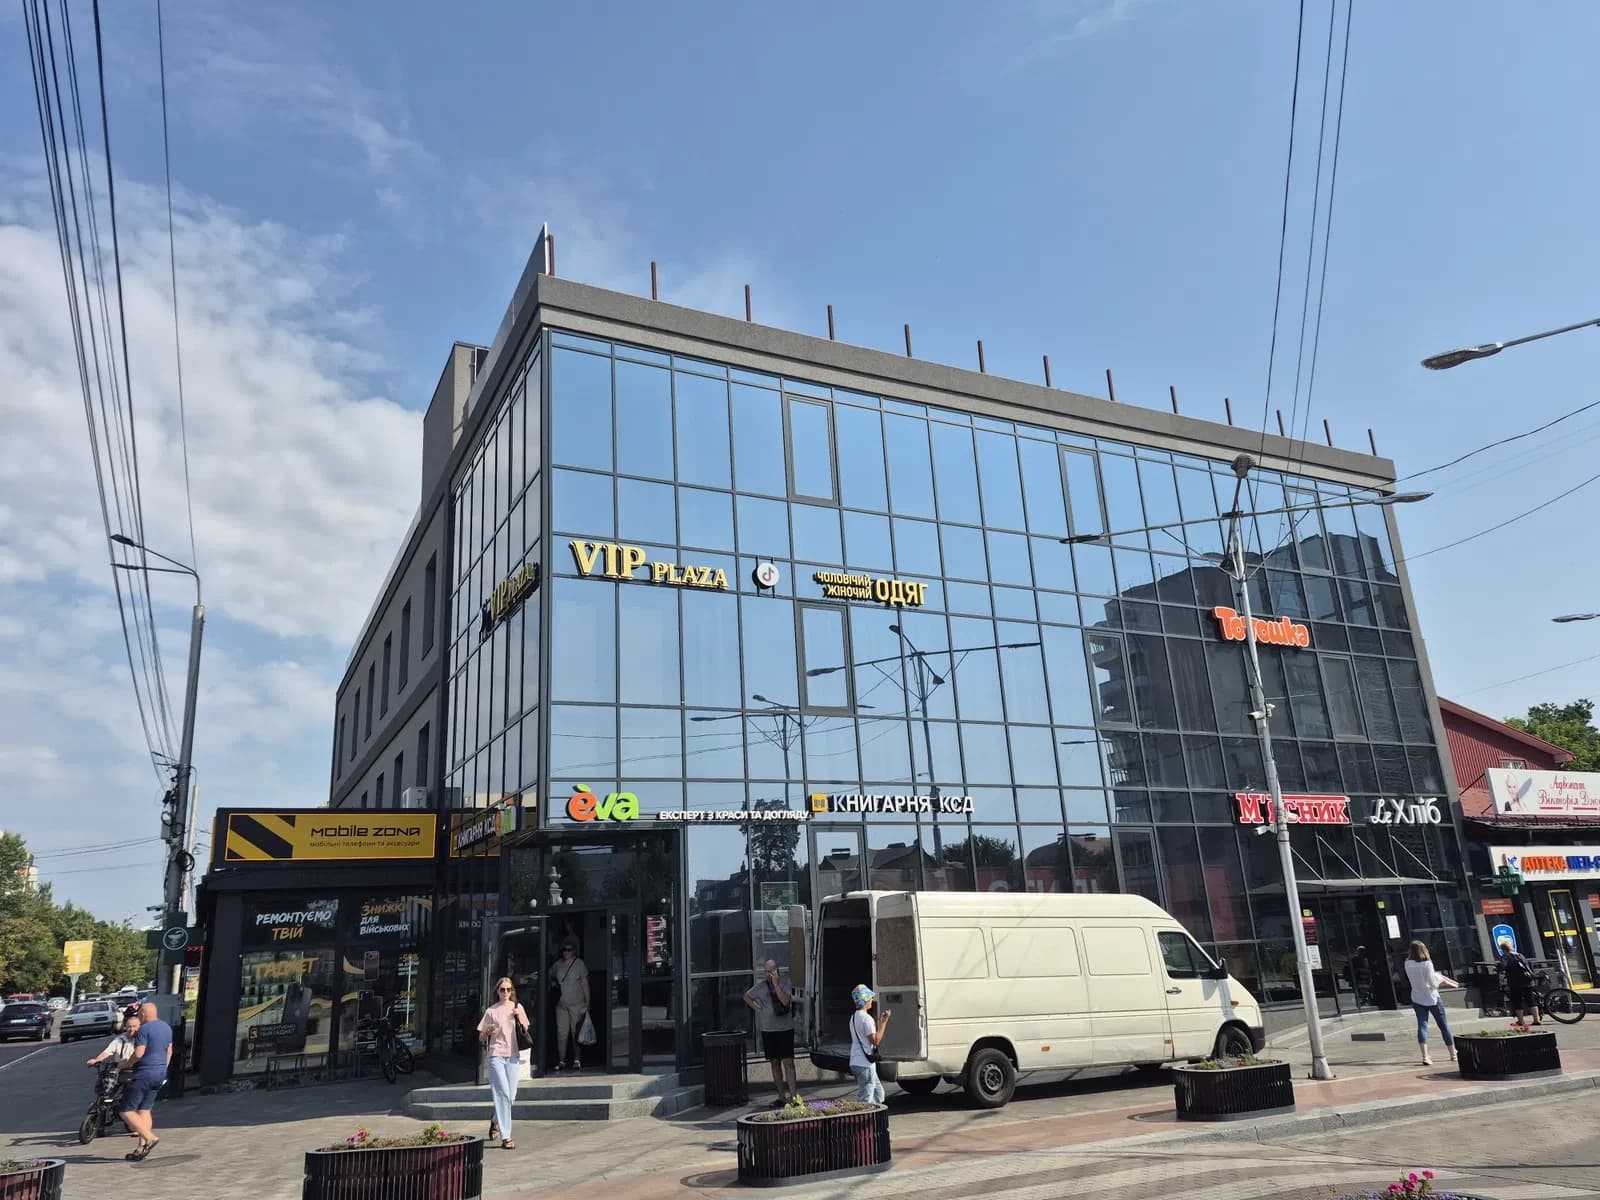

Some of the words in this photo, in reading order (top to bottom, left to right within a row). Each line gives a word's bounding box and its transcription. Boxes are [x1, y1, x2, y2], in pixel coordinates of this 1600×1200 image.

[569, 540, 646, 580] VIP
[651, 561, 729, 590] PLAZA
[815, 571, 873, 586] ЧОЛОВІЧИЙ
[826, 584, 873, 600] ЖІНОЧИЙ
[876, 578, 929, 607] ОДЯГ
[833, 793, 931, 812] КНИГАРНЯ
[939, 796, 975, 814] КСД
[659, 810, 704, 820] ЕКСПЕРТ
[715, 810, 749, 820] КРАСИ
[750, 810, 762, 820] ТА
[763, 810, 809, 821] ДОГЛЯДУ
[256, 910, 332, 925] РЕМОНТУЄМО
[360, 915, 379, 925] ДЛЯ
[272, 924, 305, 941] ТВІЙ
[360, 923, 410, 935] ВІЙСЬКОВИХ
